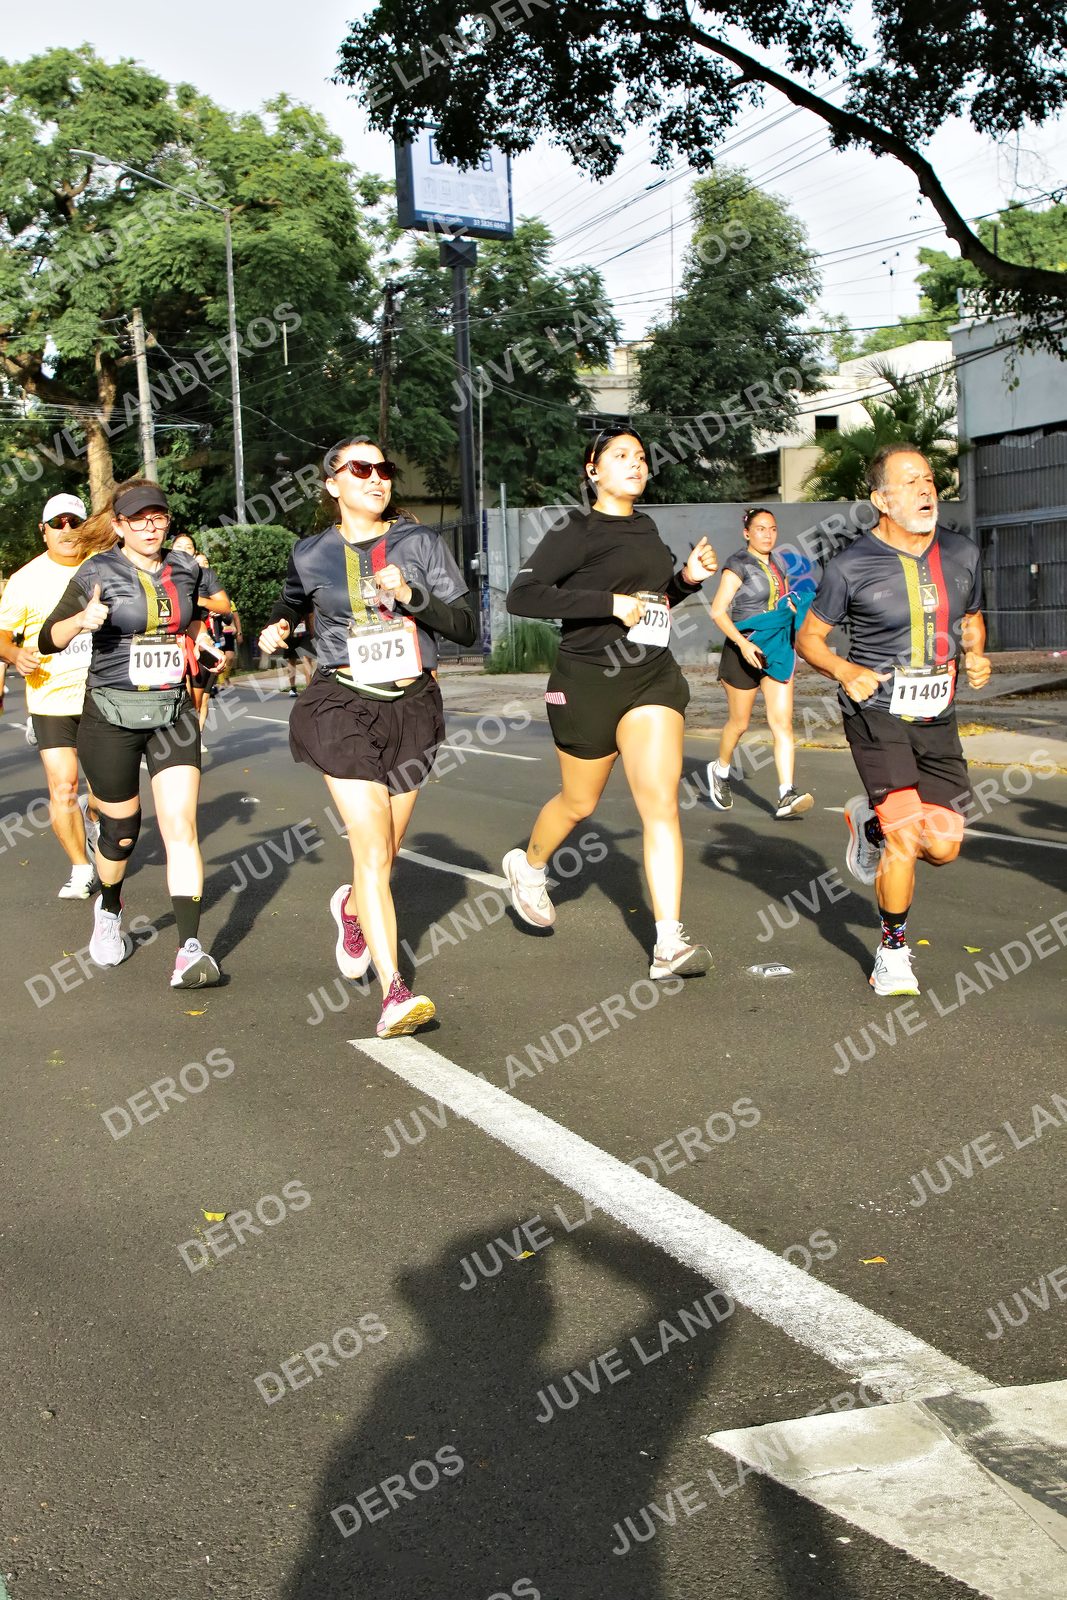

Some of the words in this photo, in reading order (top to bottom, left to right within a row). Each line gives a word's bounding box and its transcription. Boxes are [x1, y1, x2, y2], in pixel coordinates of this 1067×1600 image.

[134, 651, 181, 668] 10176
[358, 638, 405, 663] 9875
[898, 680, 949, 700] 11405
